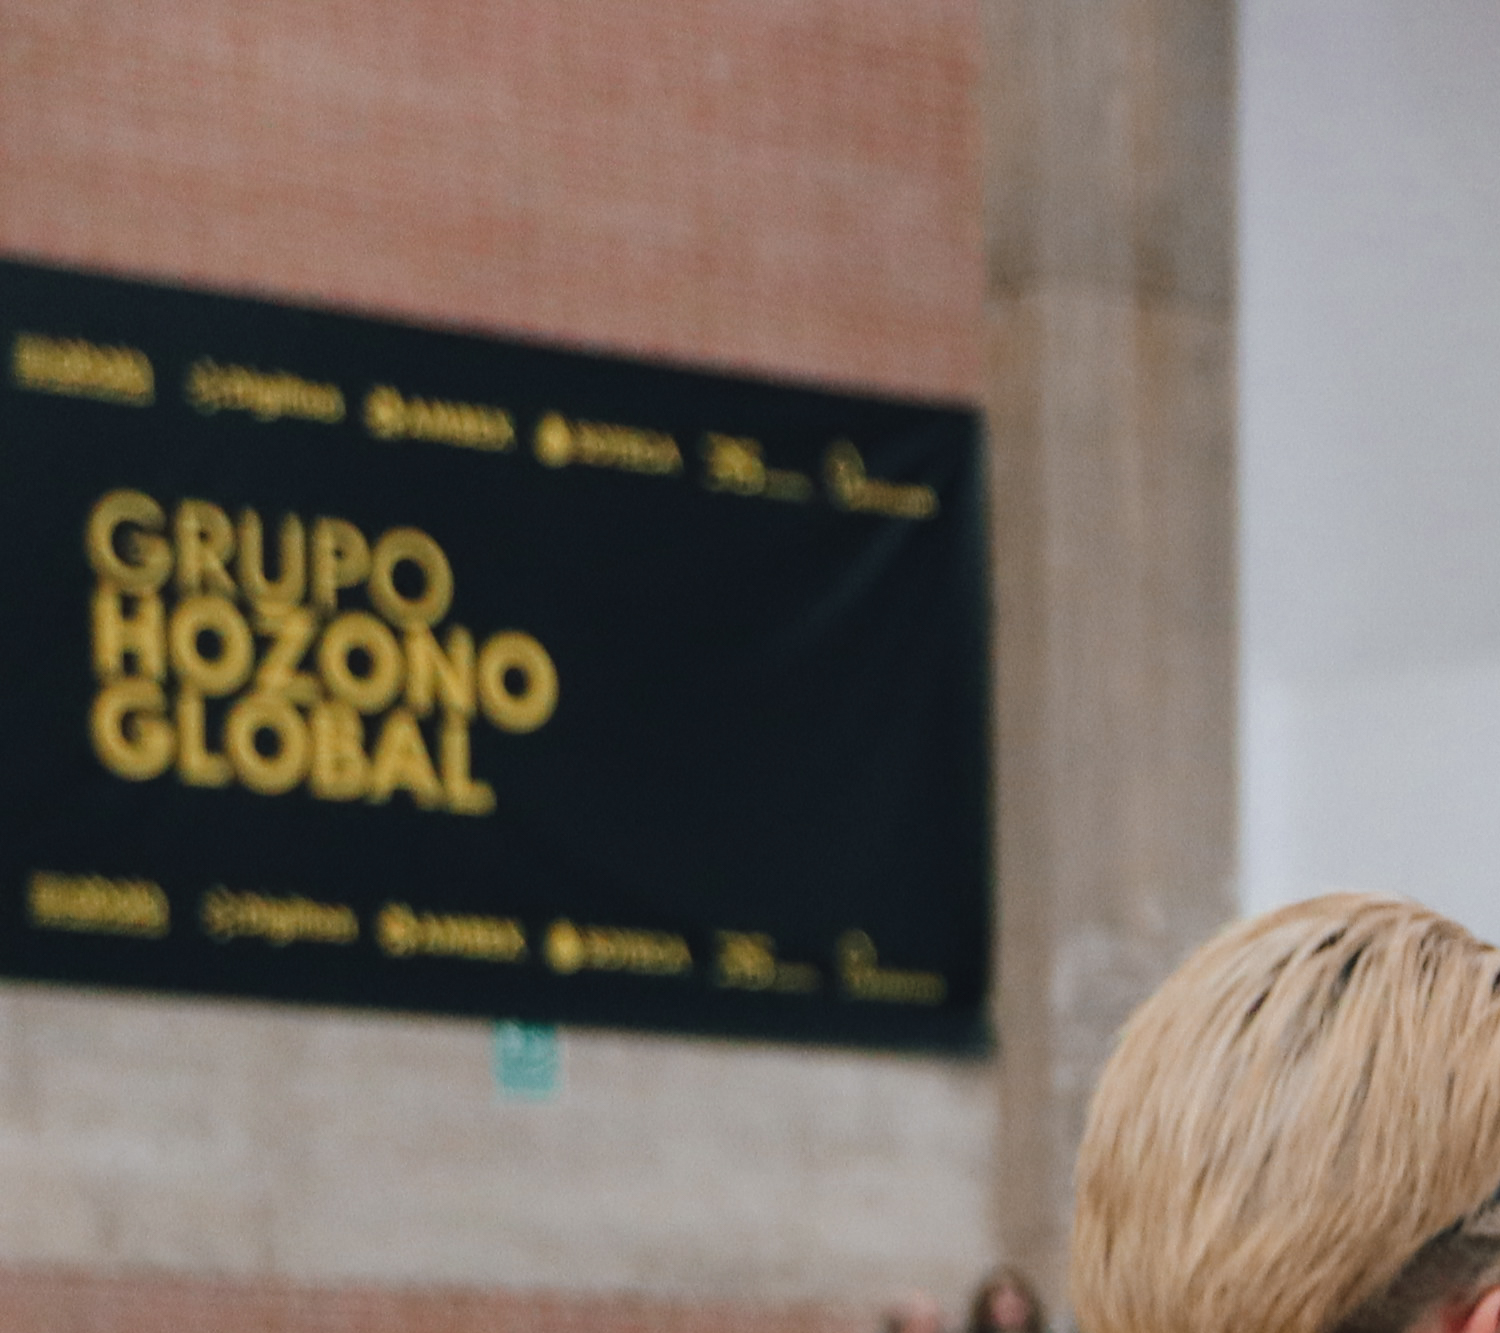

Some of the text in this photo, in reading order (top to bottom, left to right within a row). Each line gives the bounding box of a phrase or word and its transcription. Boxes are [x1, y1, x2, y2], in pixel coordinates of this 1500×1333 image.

[87, 489, 453, 628] GRUPO
[92, 588, 559, 733] HOZONO
[90, 680, 497, 815] GLOBAL
